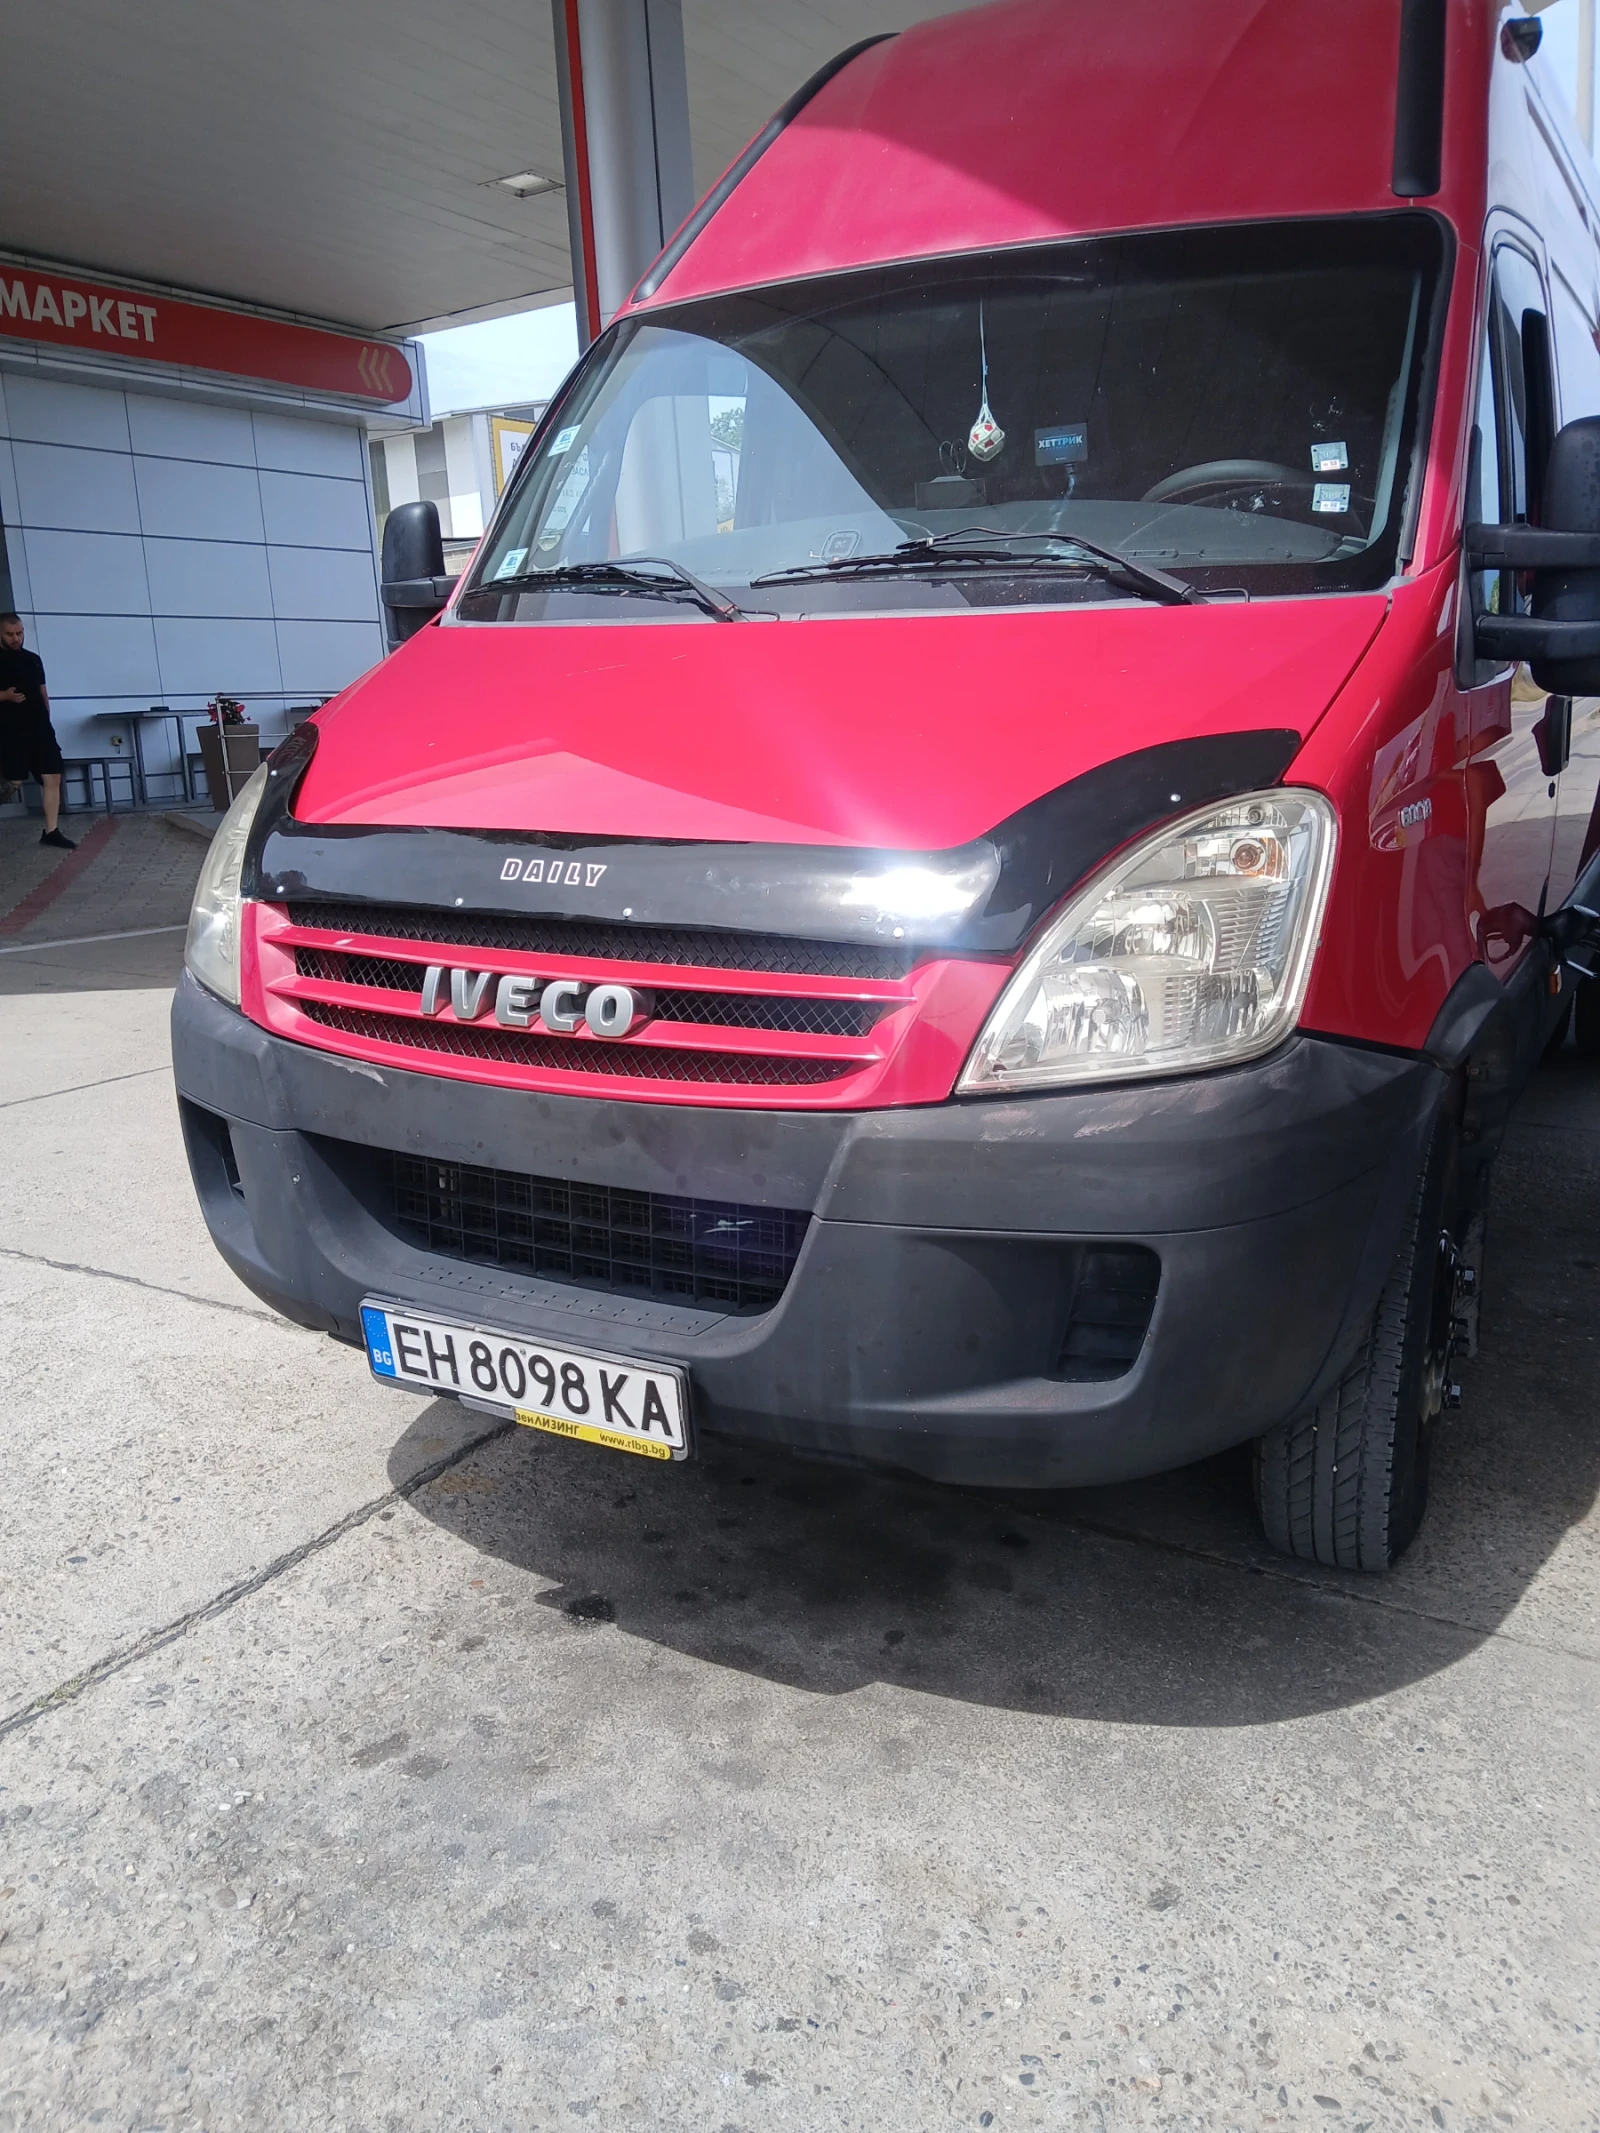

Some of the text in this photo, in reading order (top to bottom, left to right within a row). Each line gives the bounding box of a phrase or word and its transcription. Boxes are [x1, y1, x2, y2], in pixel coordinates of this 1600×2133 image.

[0, 277, 157, 343] МАРКЕТ
[1038, 435, 1083, 449] ХЕТТРИК
[500, 858, 607, 887] DAILY
[420, 965, 640, 1038] IVECO
[373, 1348, 392, 1367] BG
[600, 1431, 666, 1457] www.rlbg.bg
